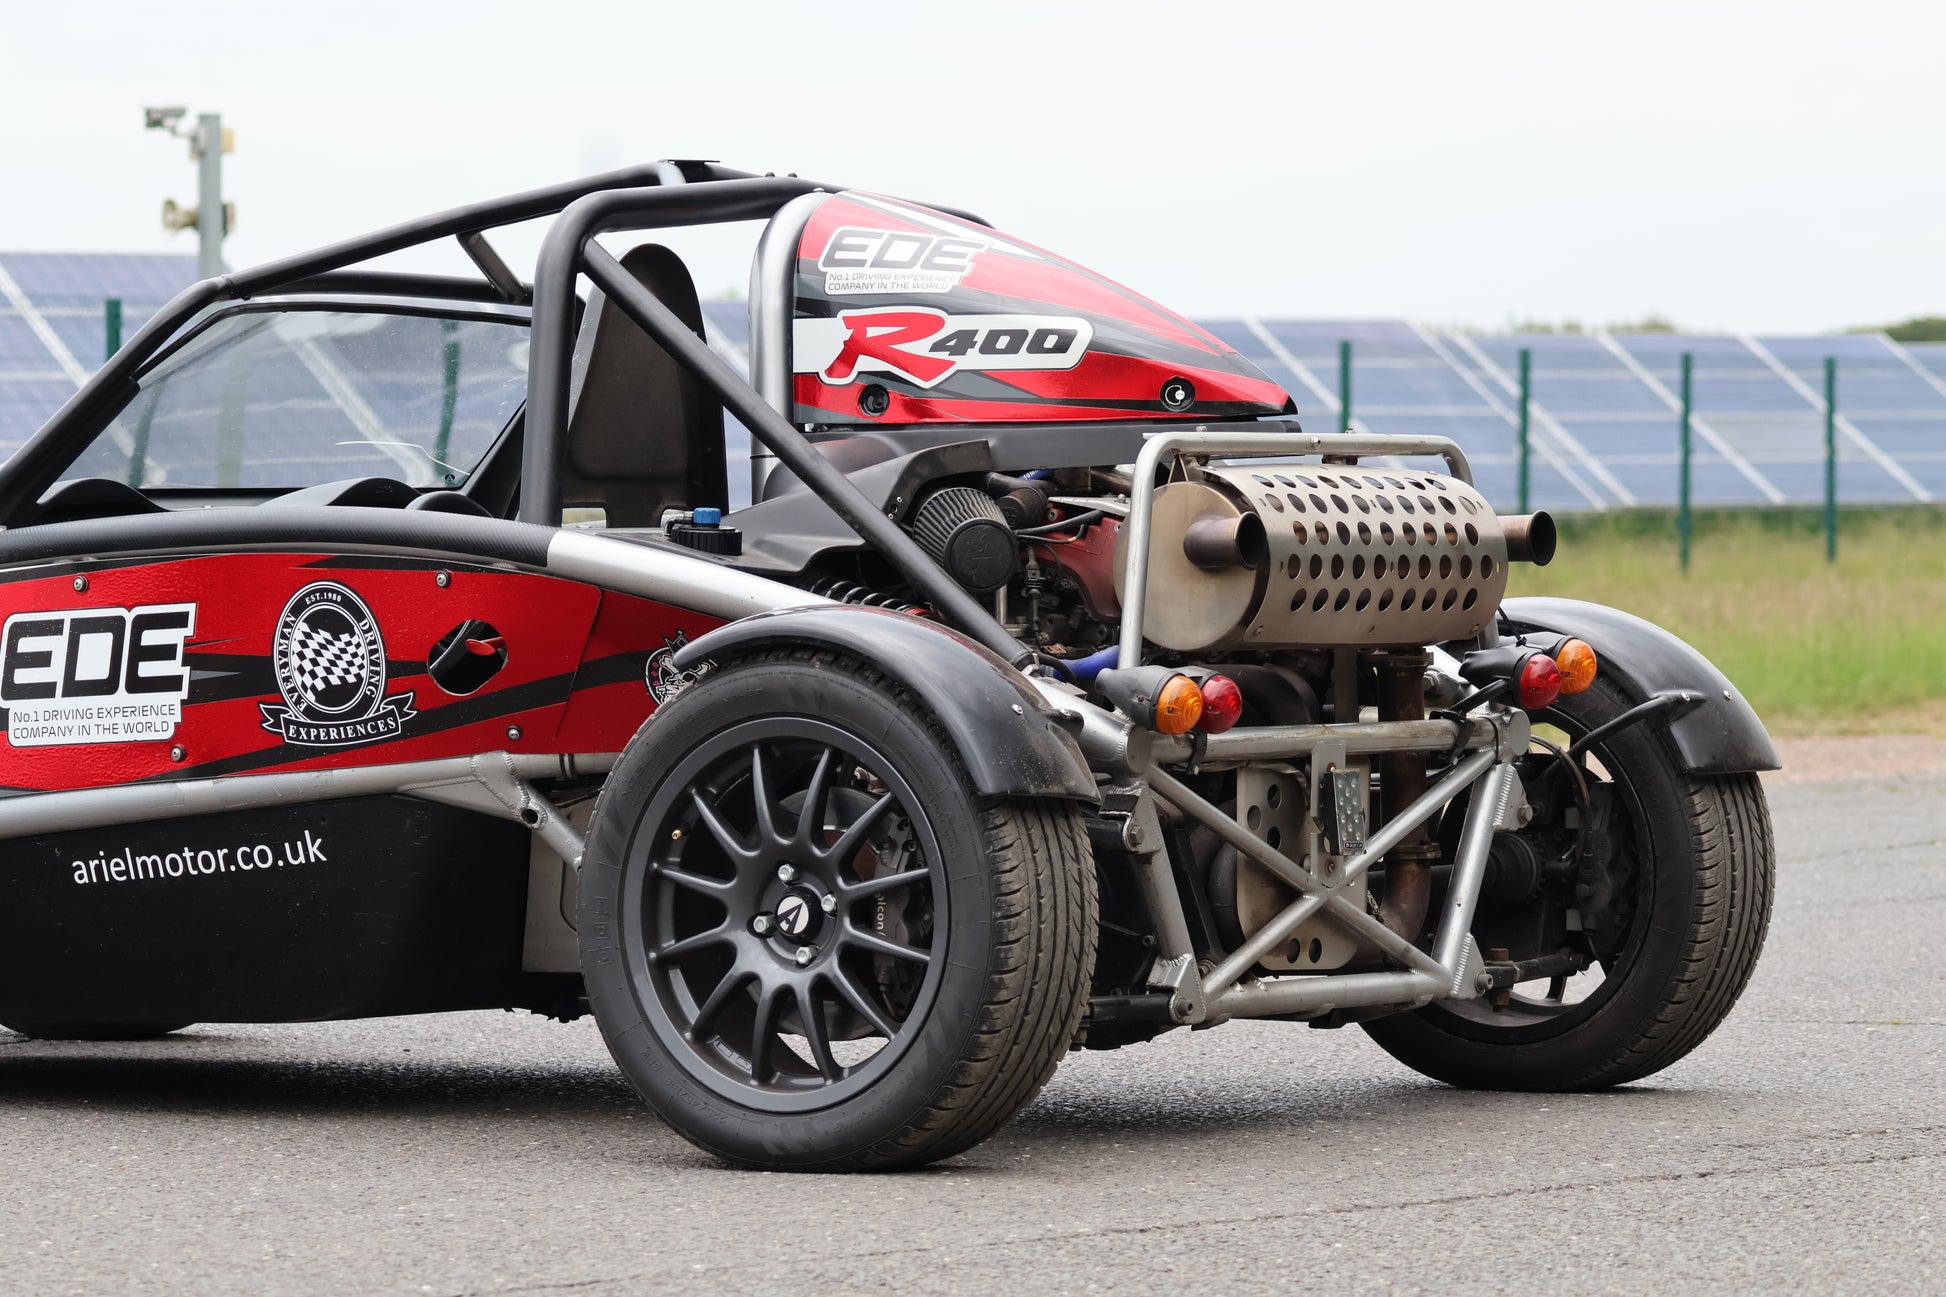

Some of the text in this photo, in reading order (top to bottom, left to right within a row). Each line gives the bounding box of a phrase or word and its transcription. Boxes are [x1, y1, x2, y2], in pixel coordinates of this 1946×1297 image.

[821, 229, 988, 273] EDE
[828, 281, 949, 291] COMPANY IN THE WORLD
[829, 272, 956, 283] No.1 DRIVING EXPERIENCE
[1, 611, 190, 701] EDE
[278, 612, 308, 713] EVERYMAN
[359, 618, 381, 698] DRIVING
[13, 704, 176, 723] No.1 DRIVING EXPERIENCE
[13, 720, 170, 740] COMPANY IN THE WORLD
[289, 716, 396, 740] EXPERIENCES
[72, 830, 328, 885] arielmotor.co.uk
